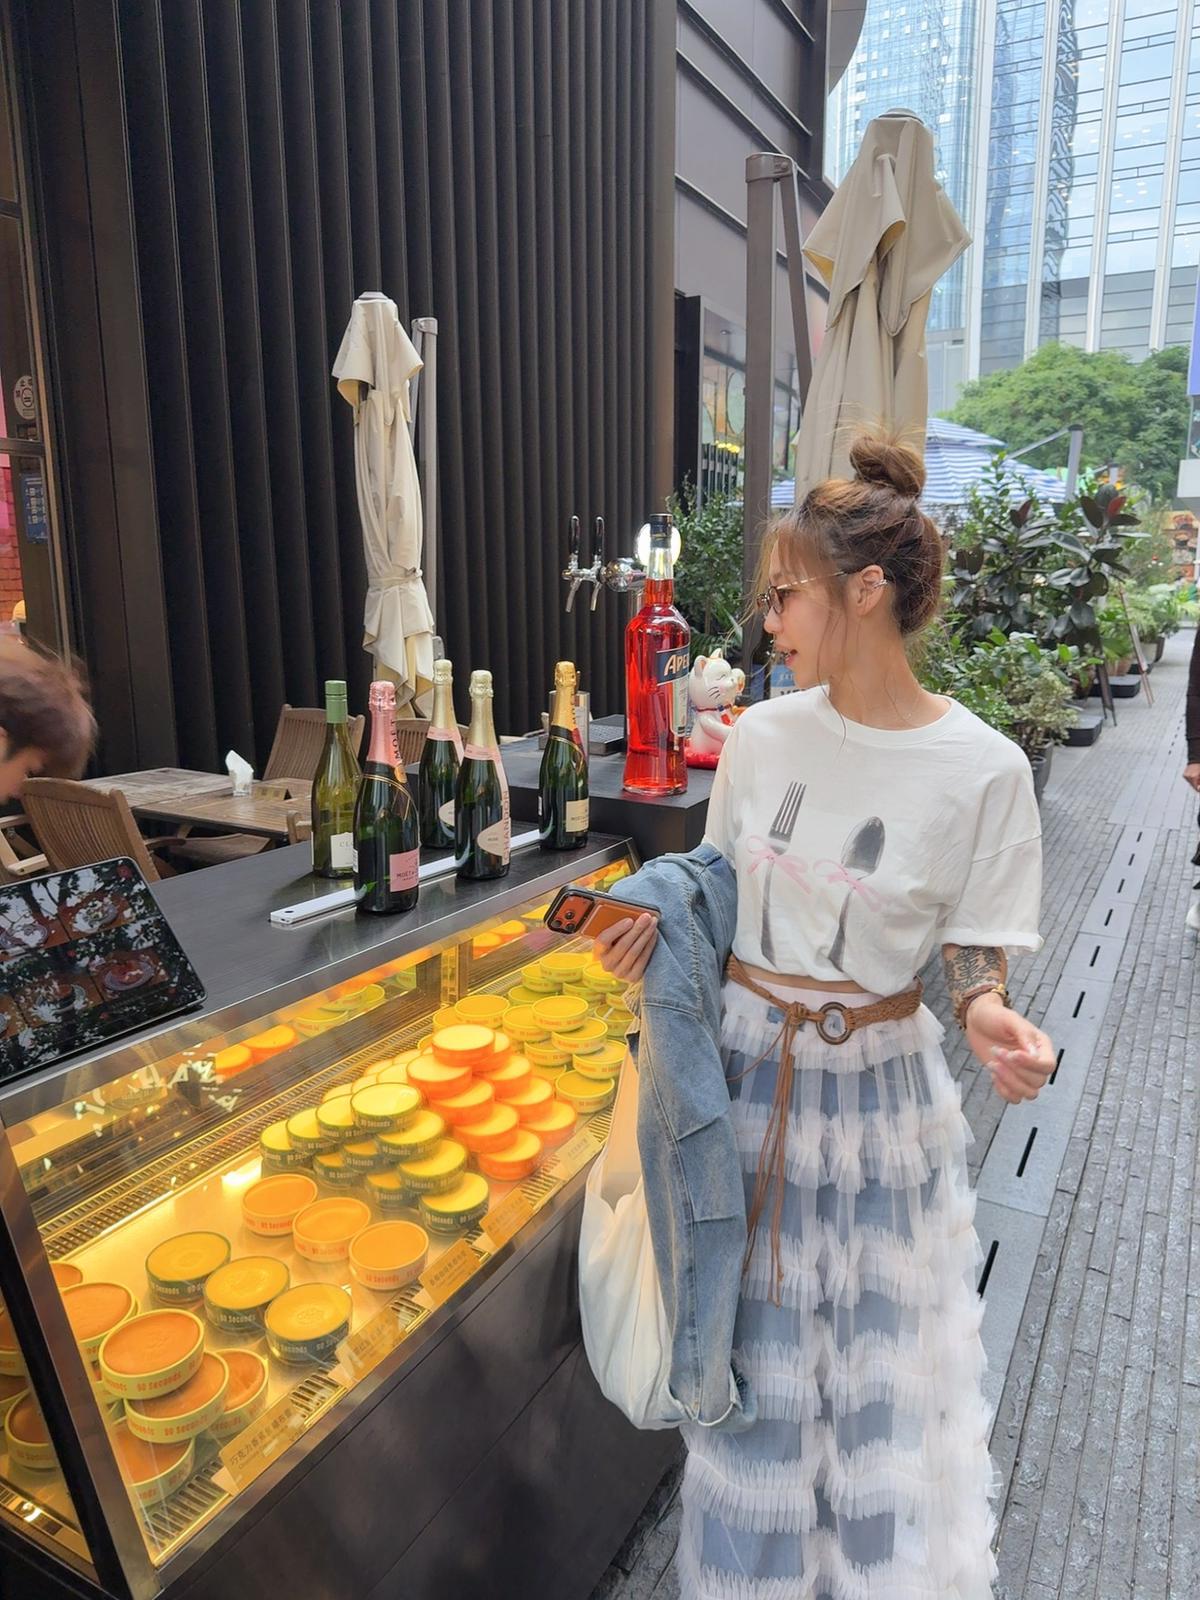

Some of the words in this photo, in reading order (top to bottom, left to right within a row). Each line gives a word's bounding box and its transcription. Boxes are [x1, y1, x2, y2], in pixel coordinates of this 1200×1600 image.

[228, 1314, 257, 1324] Seconds
[137, 1381, 147, 1392] 90
[148, 1371, 182, 1391] Seconds
[164, 1426, 176, 1437] 90
[176, 1414, 210, 1435] Seconds
